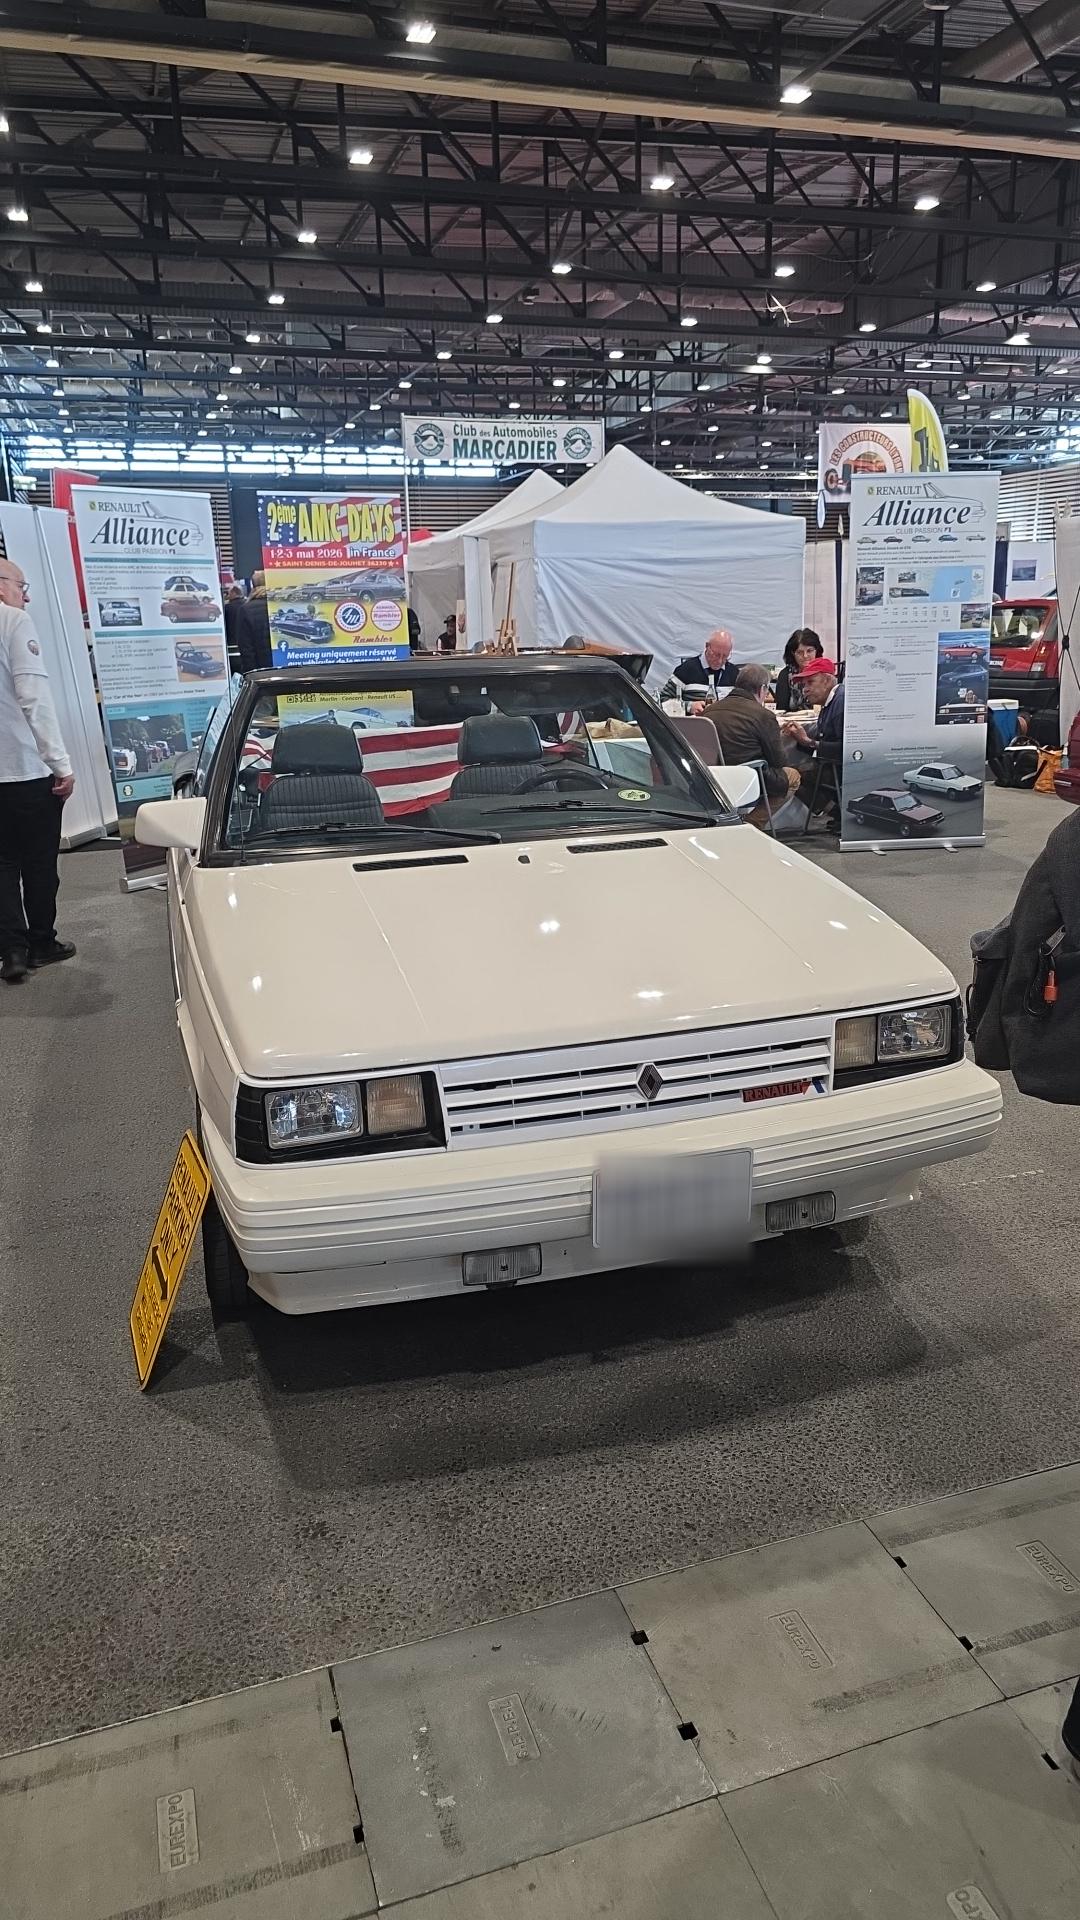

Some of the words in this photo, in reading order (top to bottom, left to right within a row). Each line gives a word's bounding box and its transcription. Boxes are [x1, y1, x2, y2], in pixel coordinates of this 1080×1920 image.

[453, 424, 477, 436] Club
[493, 426, 558, 438] Automobiles
[453, 438, 557, 460] MARCADIER
[829, 448, 843, 466] LES
[838, 430, 893, 452] CONSTRUCTEURS
[876, 485, 922, 496] RENAULT
[98, 502, 142, 513] RENAULT
[267, 499, 297, 541] 2ème
[298, 503, 342, 543] AMC
[346, 503, 396, 543] DAYS
[862, 500, 972, 526] Alliance
[90, 516, 190, 546] Alliance
[317, 548, 343, 559] 2026
[349, 547, 359, 558] in
[361, 547, 395, 558] France
[287, 651, 320, 660] Meeting
[321, 649, 367, 659] uniquement
[369, 648, 397, 656] réservé
[744, 1080, 802, 1101] RENAULT
[175, 1152, 202, 1218] RENAULT
[166, 1180, 191, 1249] PARKING
[160, 1216, 180, 1268] ONLY
[1024, 1545, 1076, 1592] EUREXPO
[778, 1615, 822, 1670] EUREXPO
[168, 1793, 187, 1869] EUREXPO
